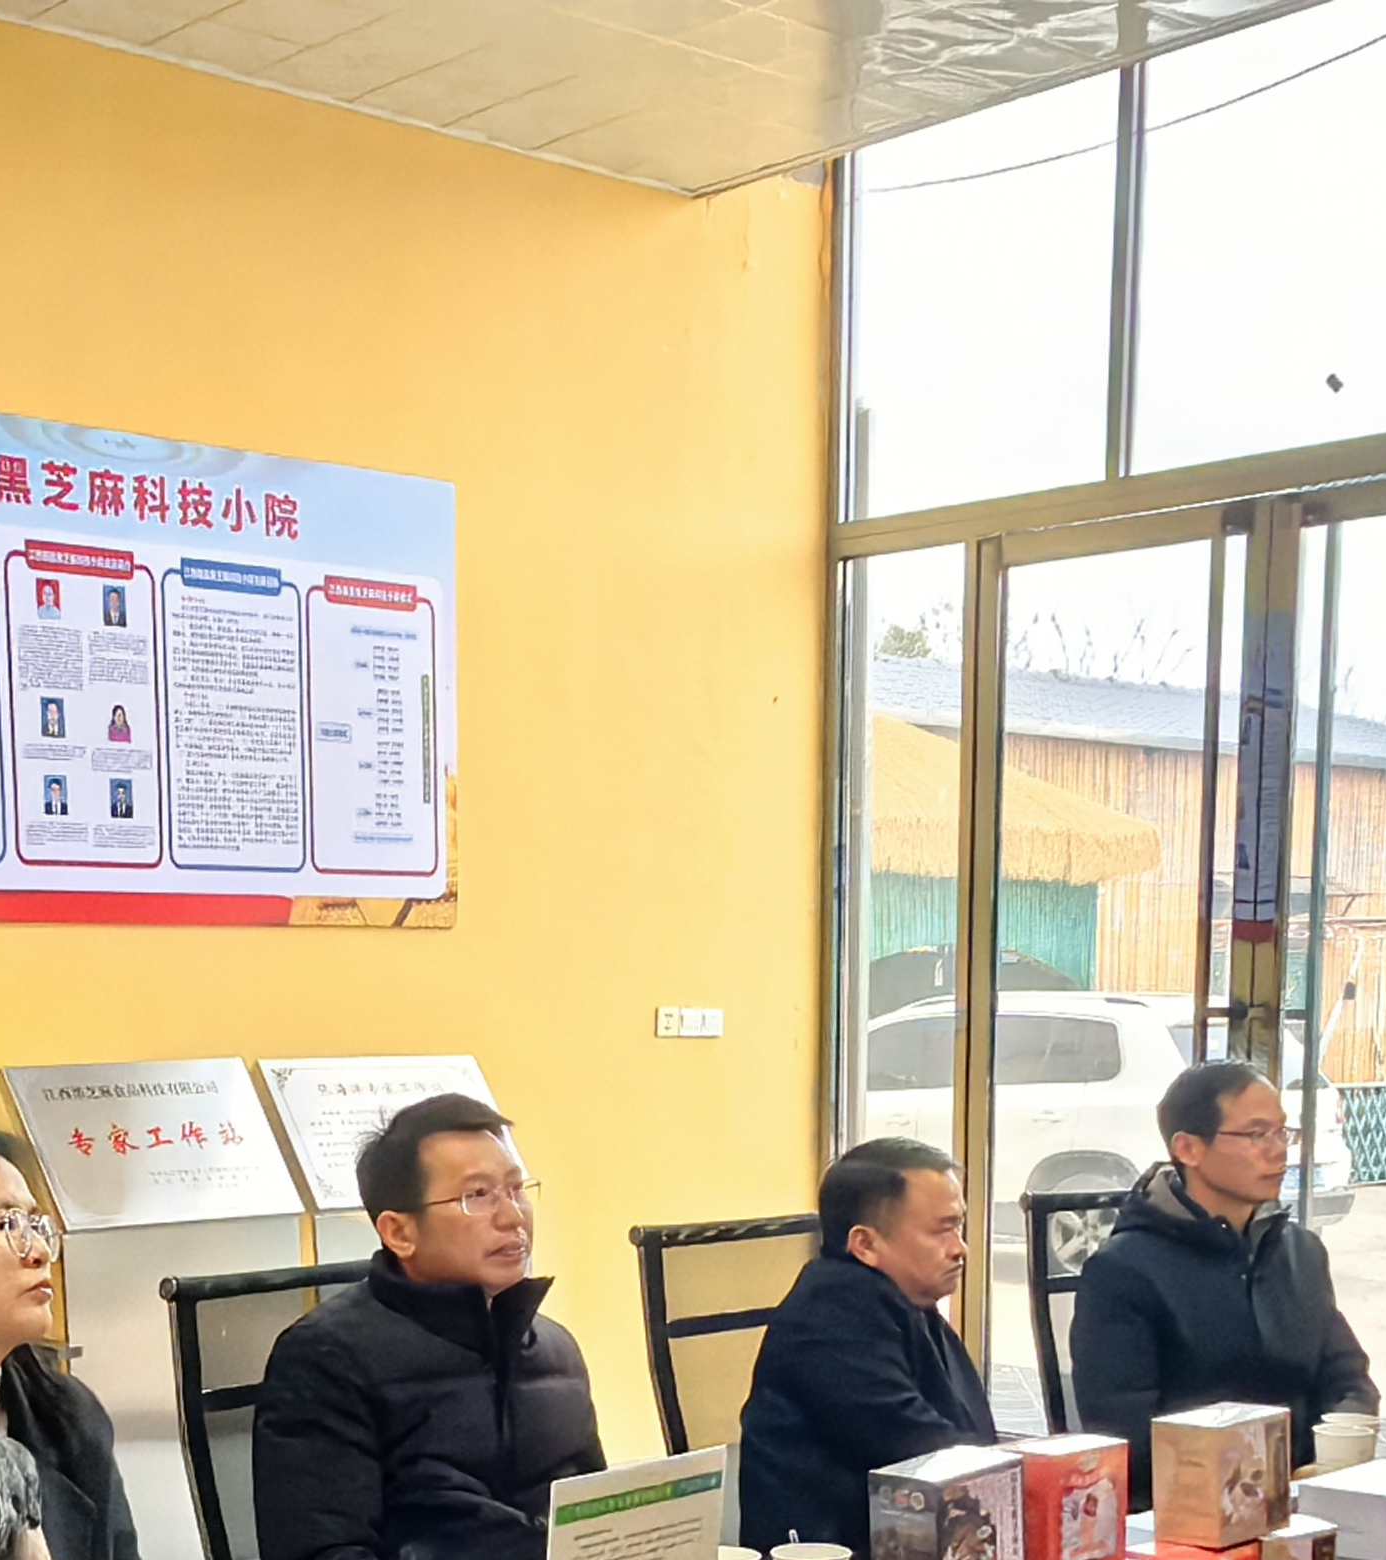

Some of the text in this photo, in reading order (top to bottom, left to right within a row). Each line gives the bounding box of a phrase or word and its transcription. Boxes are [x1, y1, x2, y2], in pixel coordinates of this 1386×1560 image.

[68, 1121, 244, 1156] 专家工作站
